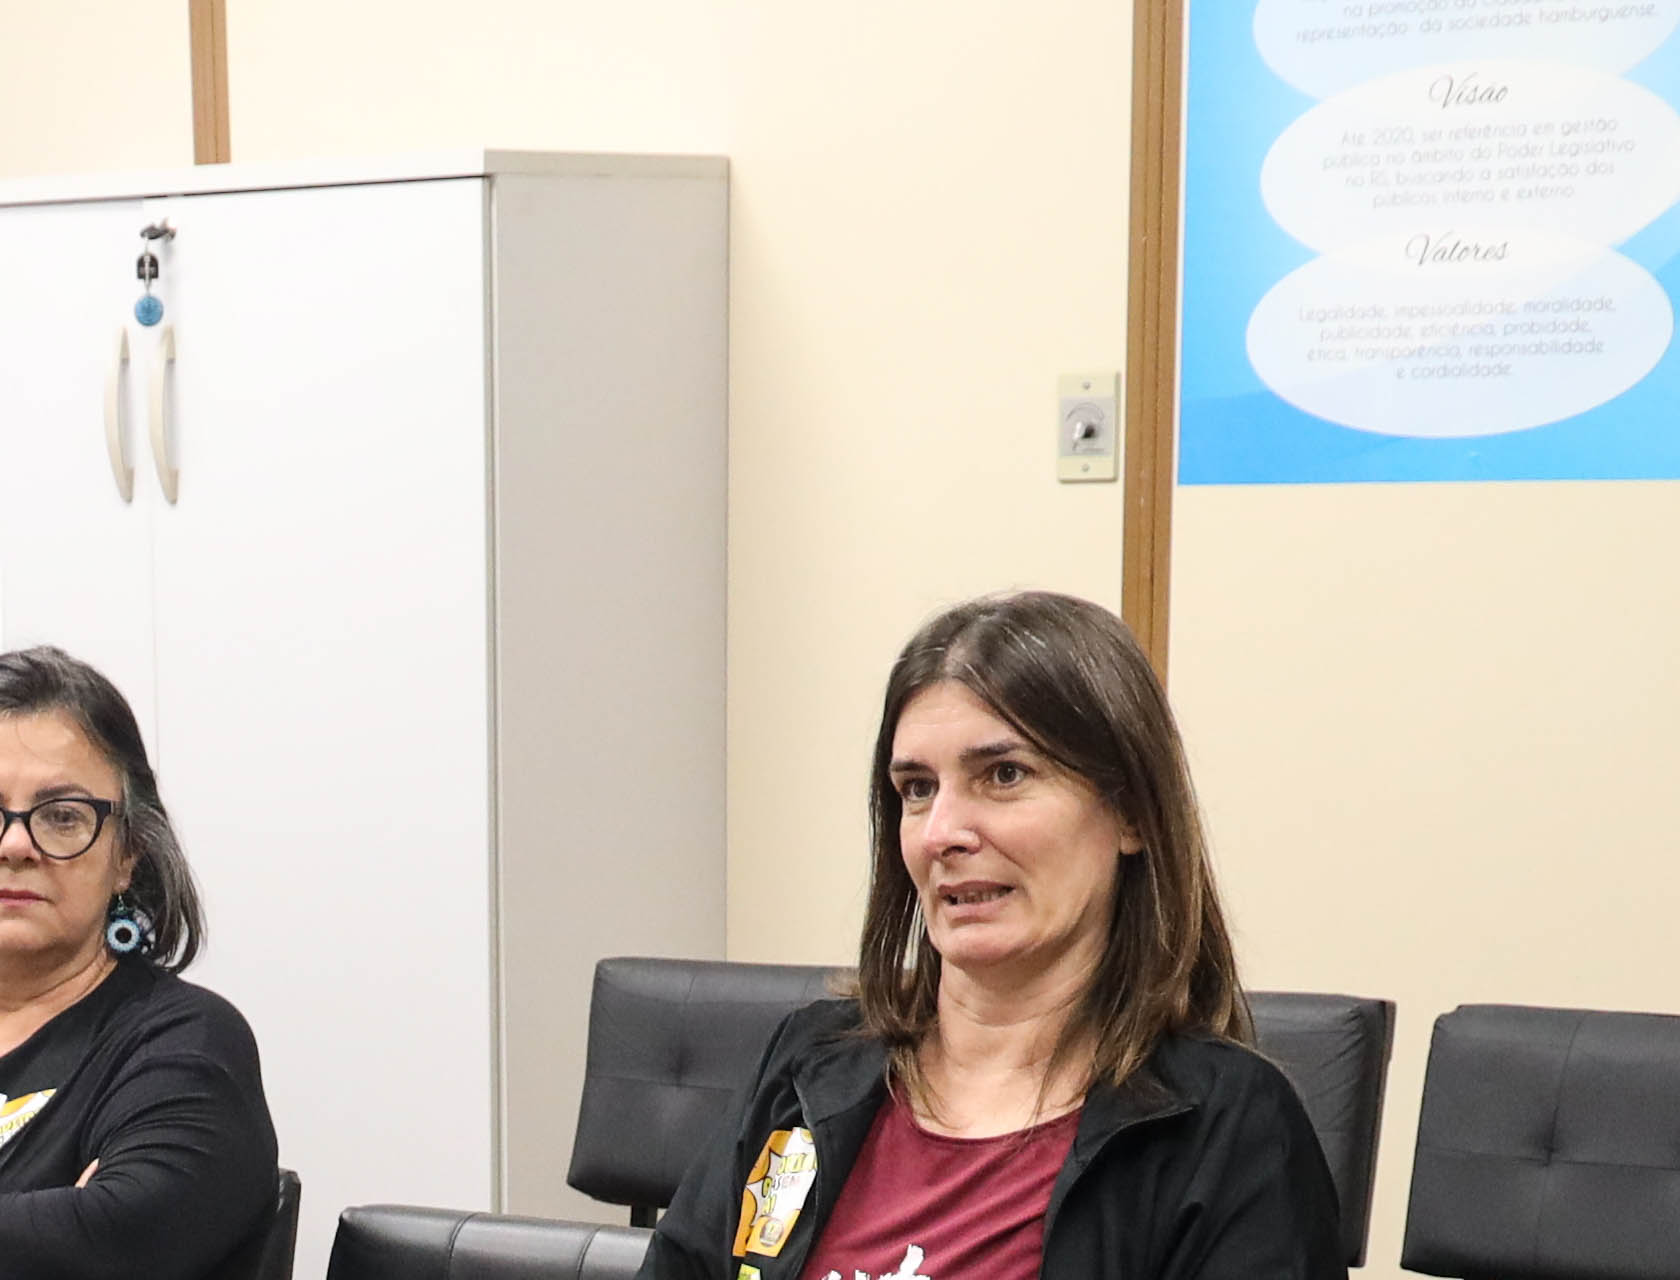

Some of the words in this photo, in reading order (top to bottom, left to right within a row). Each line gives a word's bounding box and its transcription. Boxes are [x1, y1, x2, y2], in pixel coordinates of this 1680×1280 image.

[1448, 12, 1532, 33] sociedade
[1428, 72, 1509, 110] Visão
[1405, 228, 1511, 268] Valores
